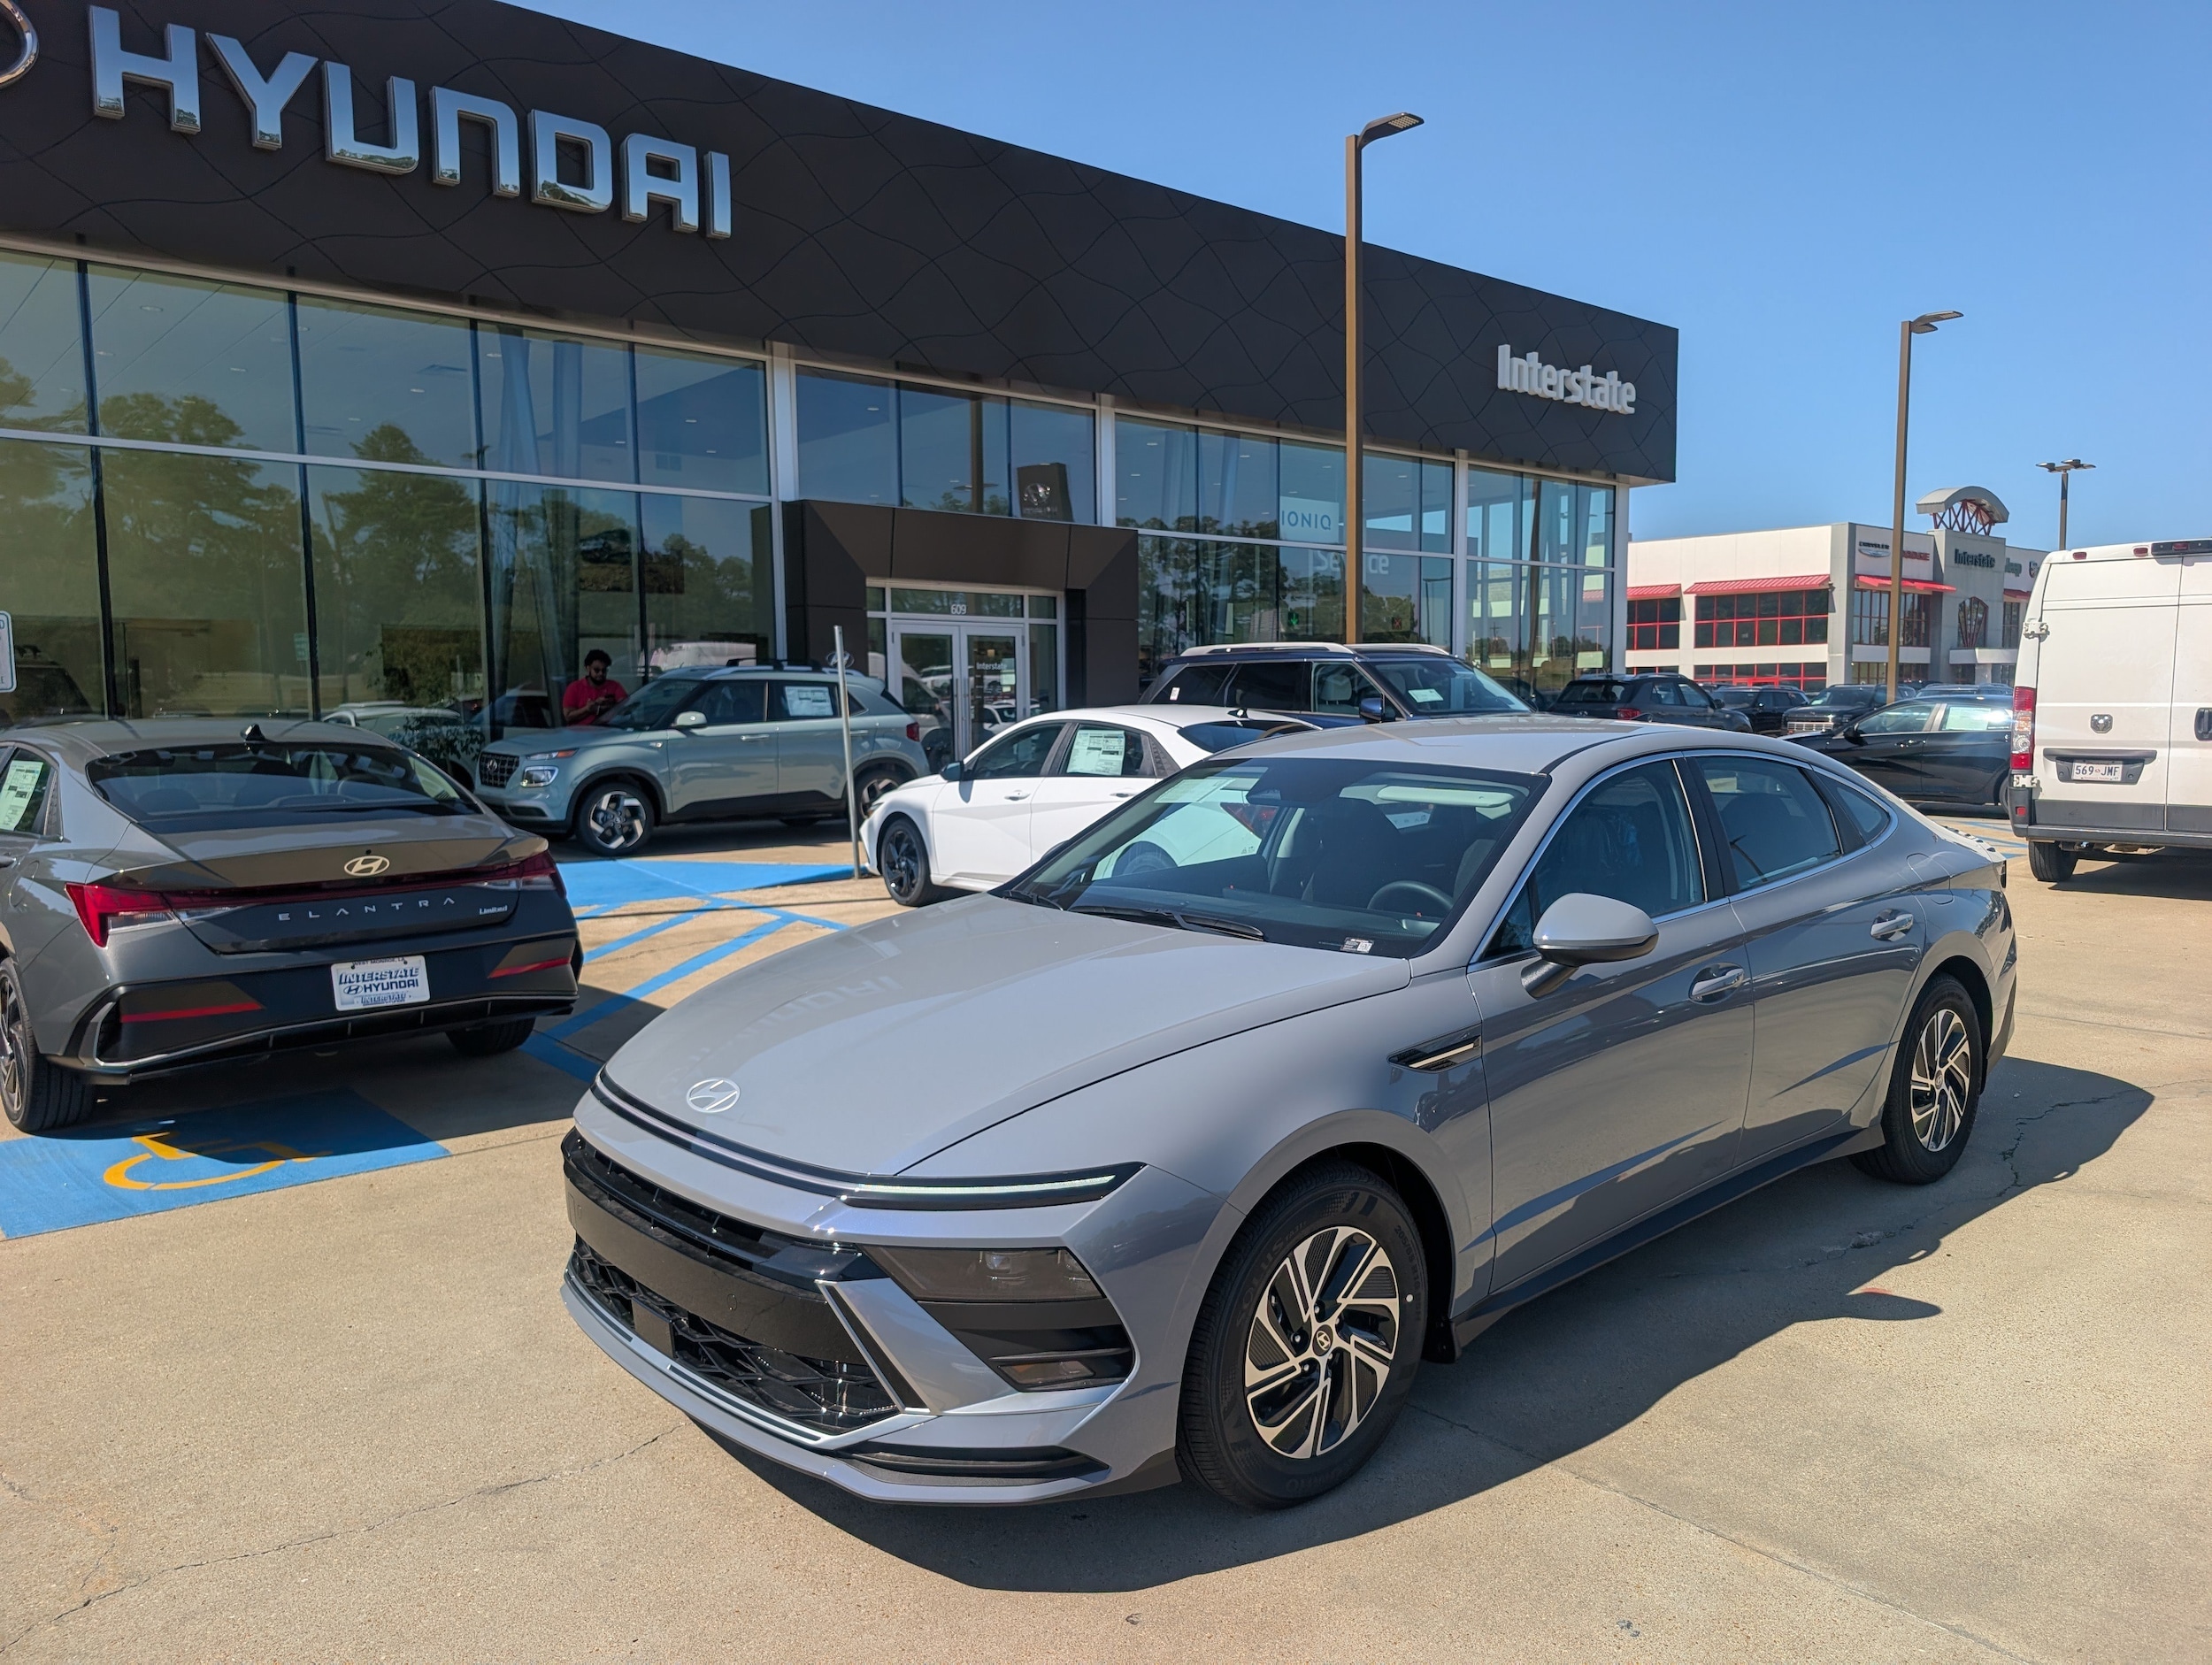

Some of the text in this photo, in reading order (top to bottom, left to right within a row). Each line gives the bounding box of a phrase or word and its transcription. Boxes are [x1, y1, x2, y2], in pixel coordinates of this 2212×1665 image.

[88, 4, 731, 239] HYUNDAI
[1497, 343, 1637, 415] Interstate
[1281, 510, 1332, 531] IONIQ
[1954, 548, 1996, 568] Interstate
[950, 603, 967, 615] 609
[2075, 765, 2120, 777] 569 JMF
[278, 897, 456, 922] ELANTRA
[479, 904, 509, 916] Limited
[339, 967, 419, 986] INTERSTATE
[364, 978, 419, 993] HYUNDAI
